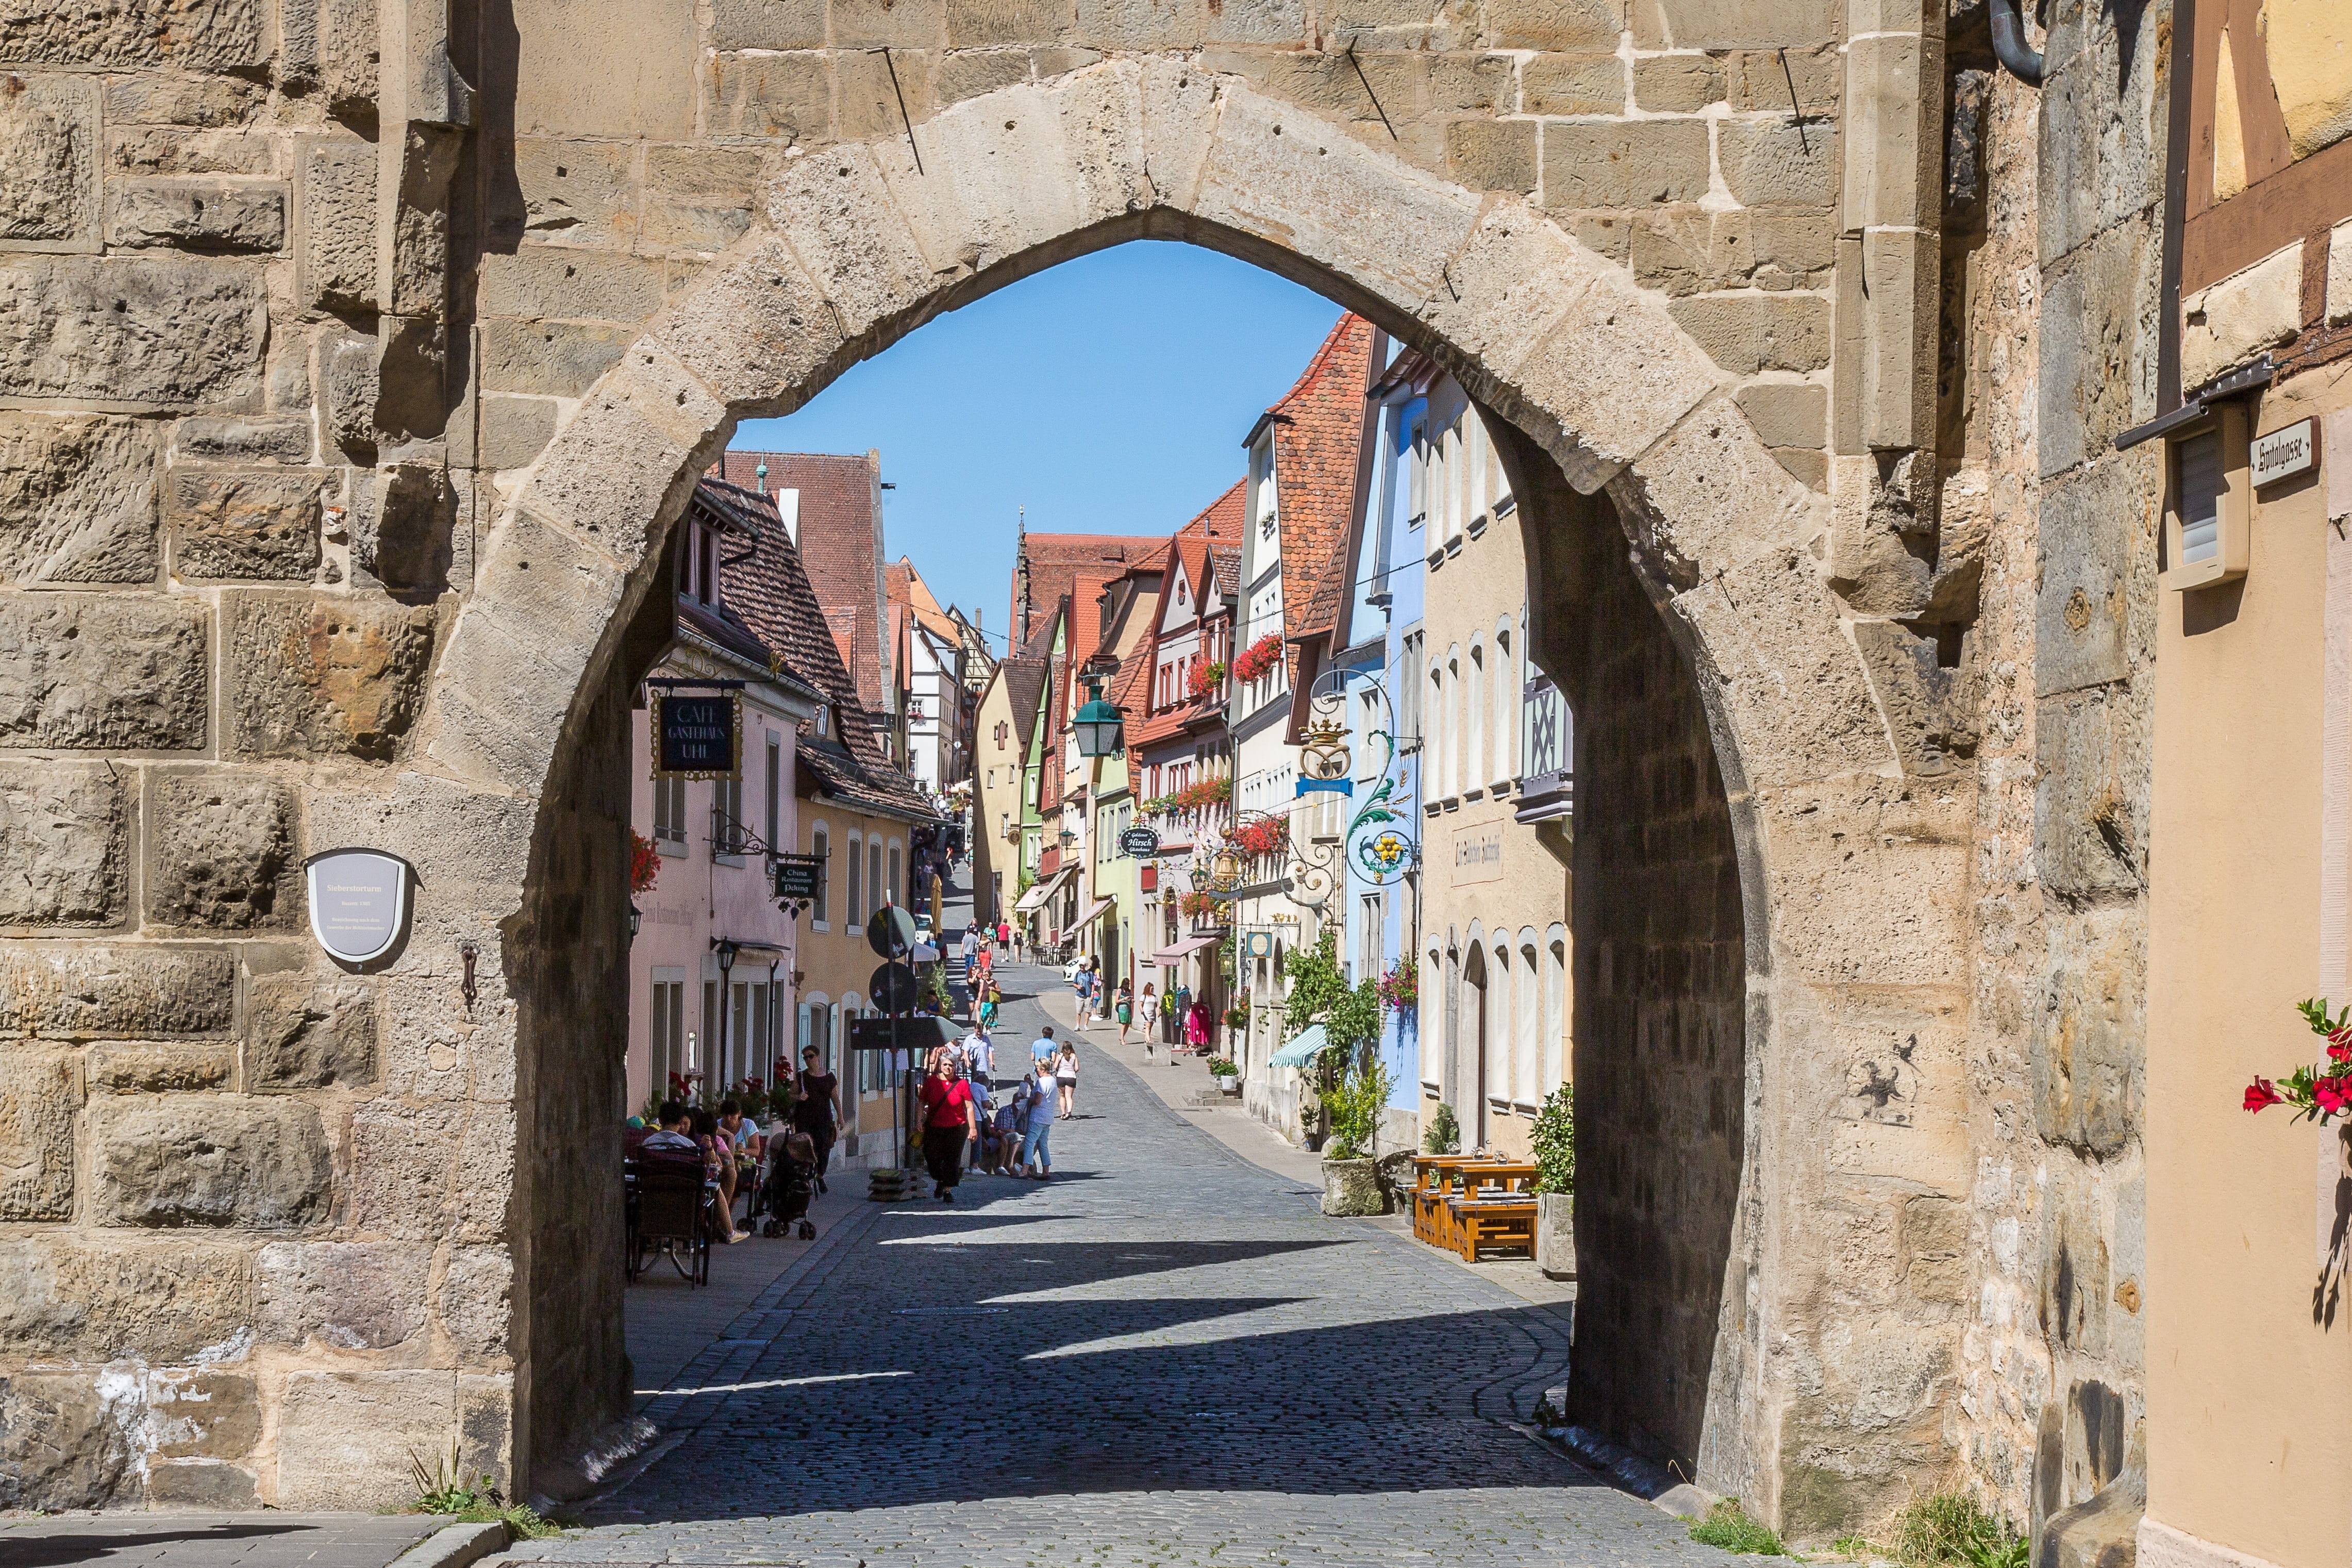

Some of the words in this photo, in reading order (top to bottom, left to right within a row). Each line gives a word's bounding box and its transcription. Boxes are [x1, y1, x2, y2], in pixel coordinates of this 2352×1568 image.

[2258, 435, 2302, 474] Spitalgasse
[1127, 838, 1152, 846] Hirsch
[785, 884, 808, 893] Peking
